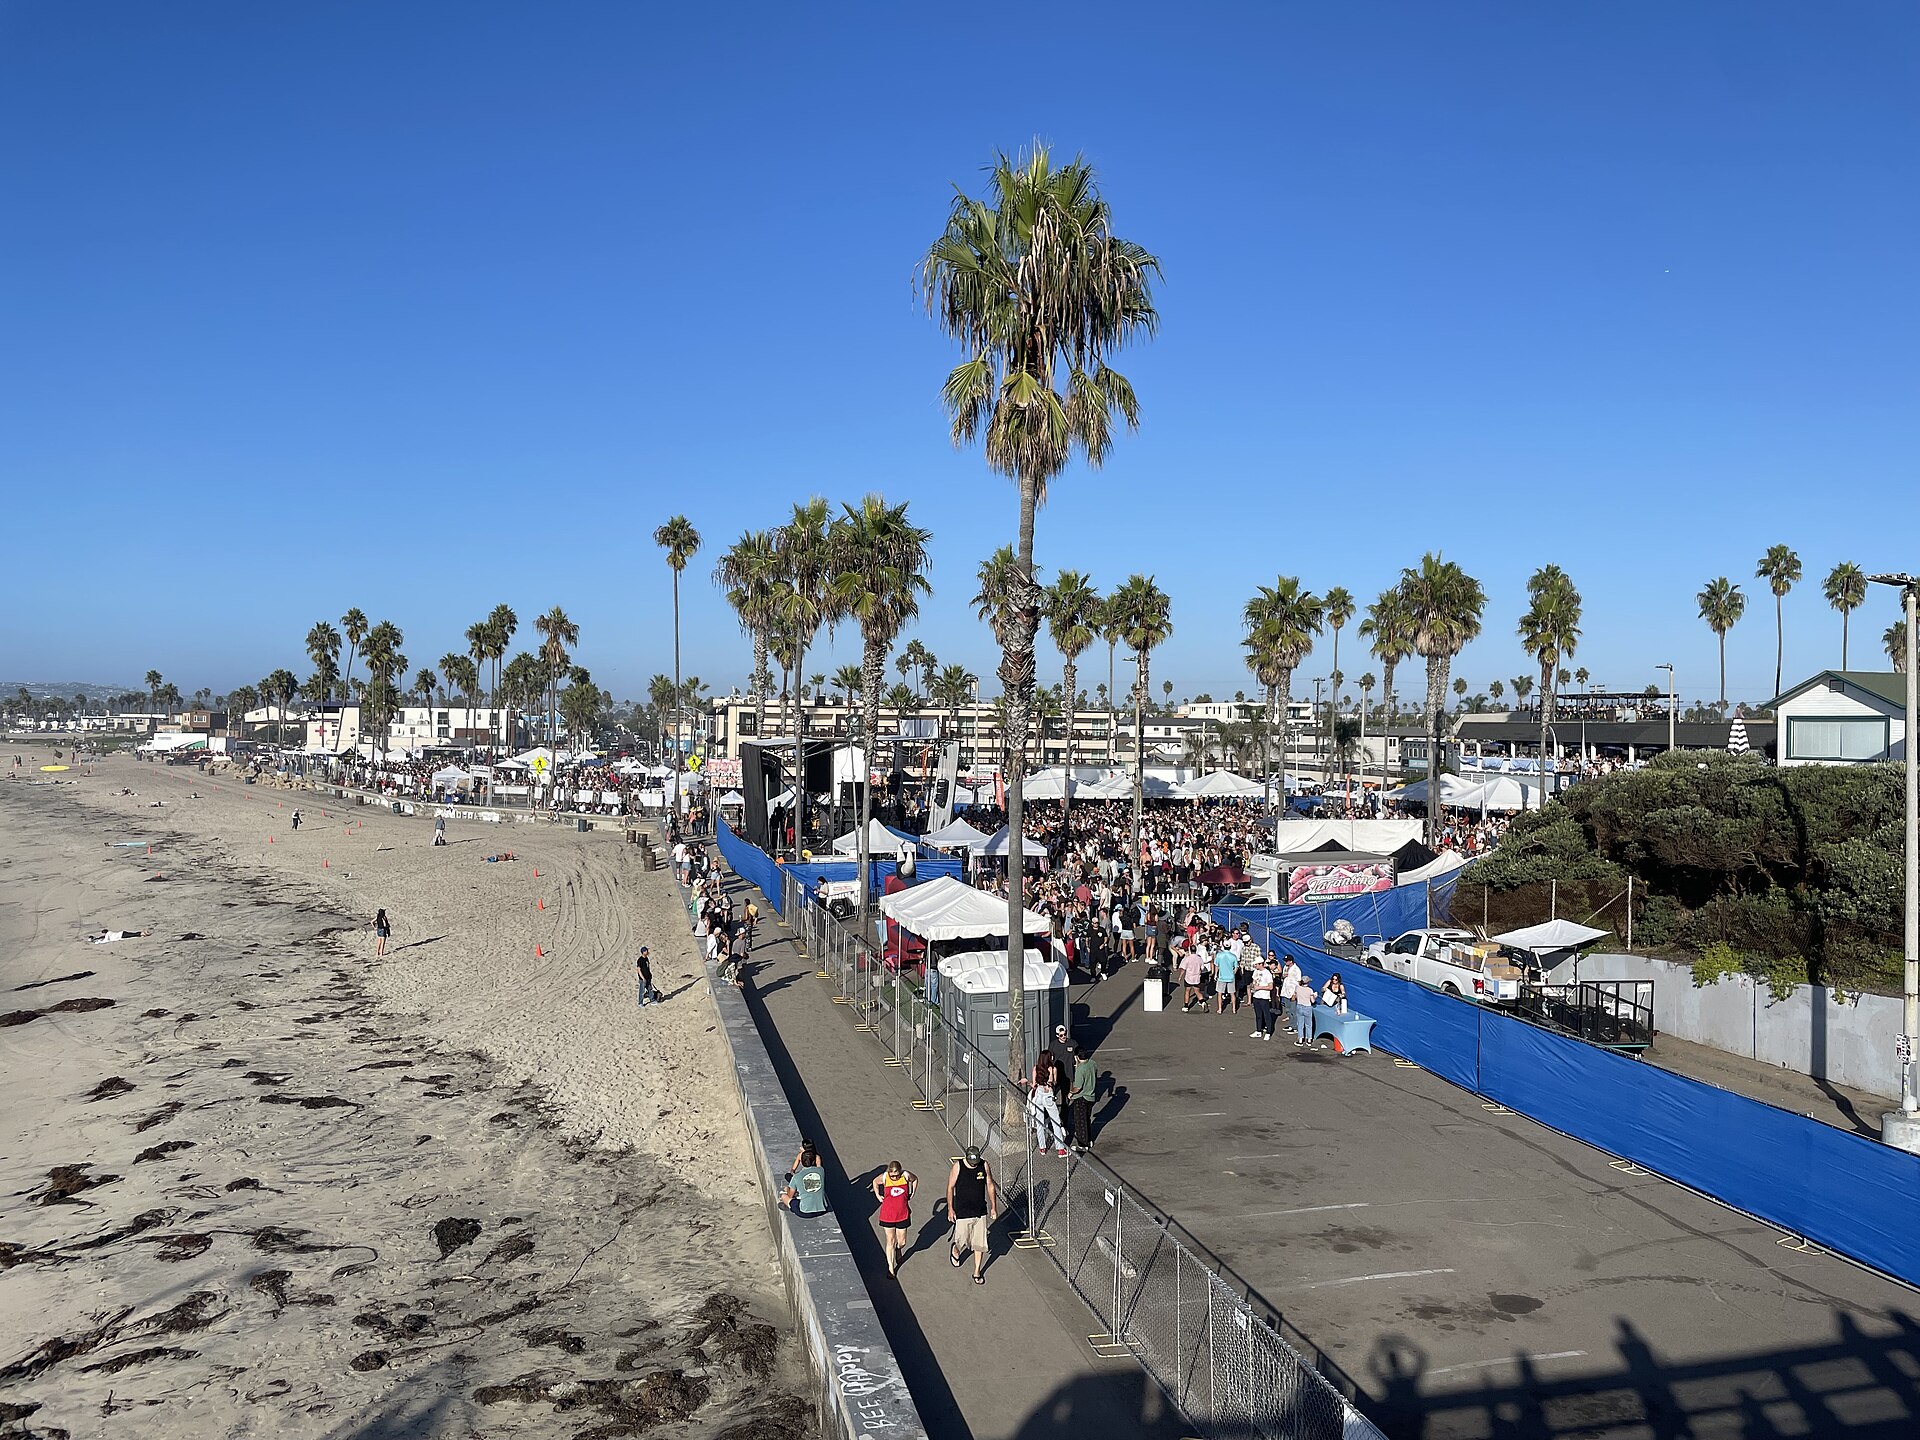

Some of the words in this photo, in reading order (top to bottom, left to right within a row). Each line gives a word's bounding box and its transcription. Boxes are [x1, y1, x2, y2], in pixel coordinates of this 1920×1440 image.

[1309, 872, 1375, 892] Tarantino
[834, 1344, 873, 1393] HAPPY
[857, 1398, 897, 1429] BEE
